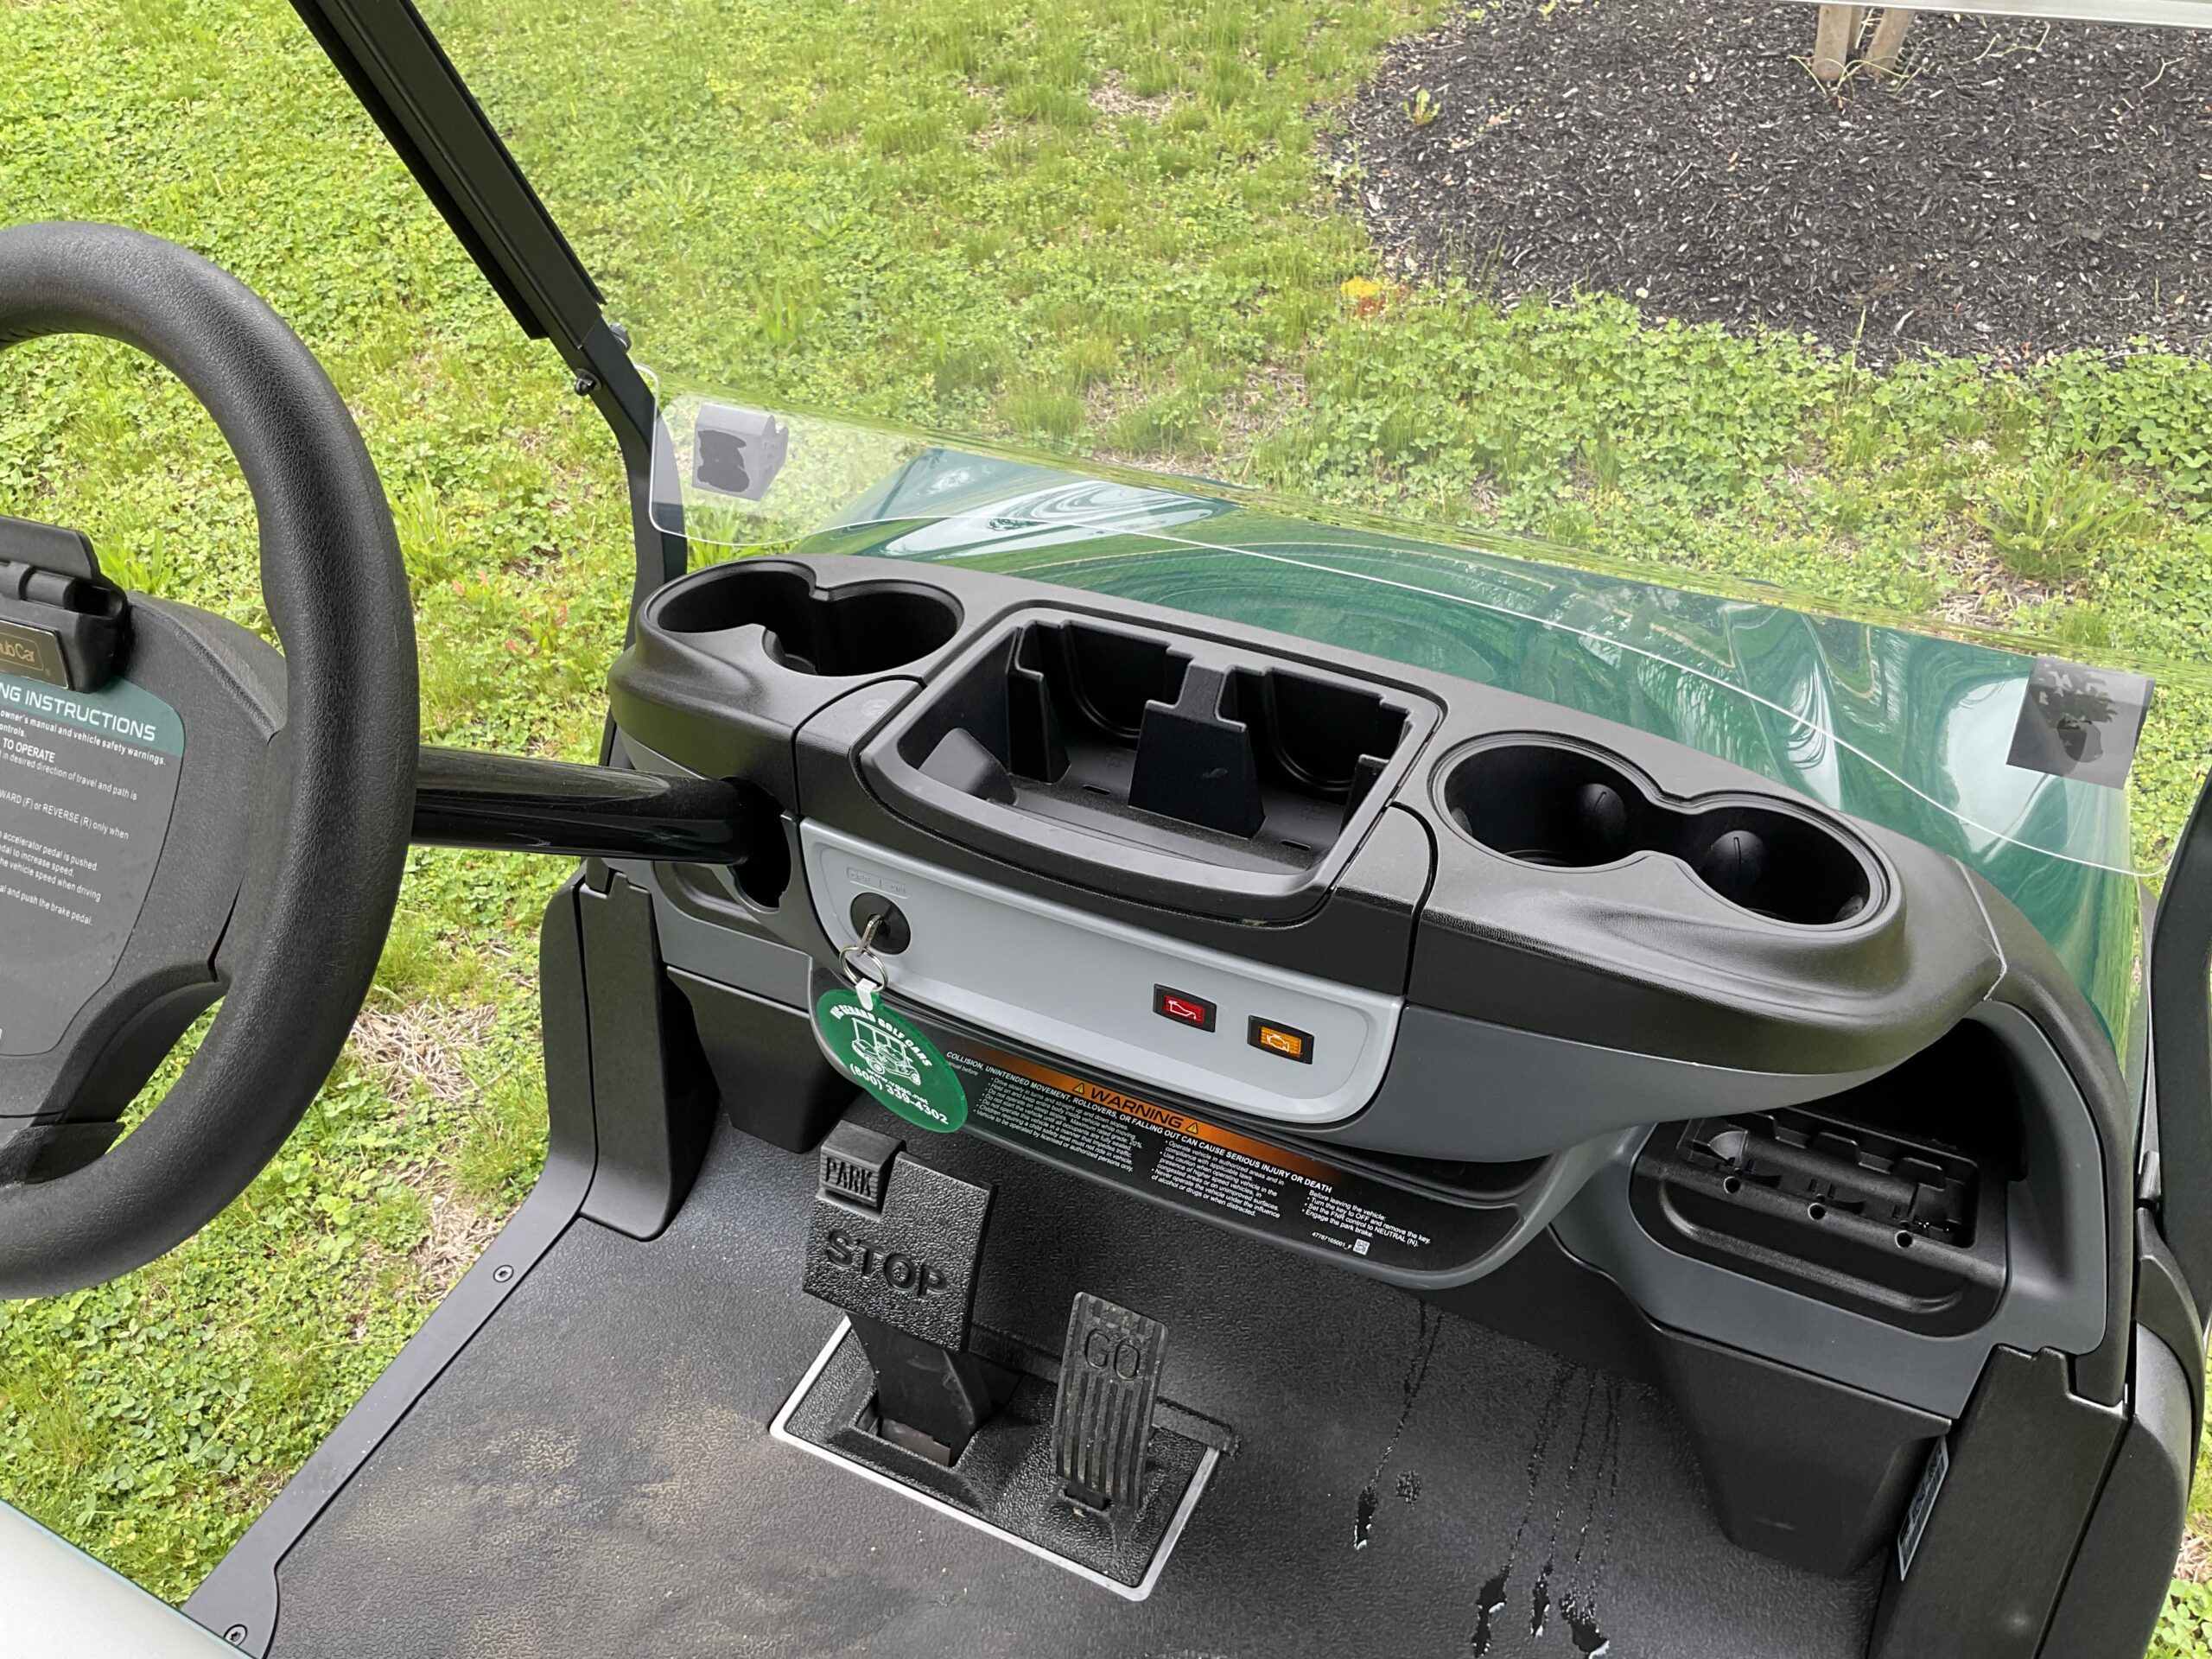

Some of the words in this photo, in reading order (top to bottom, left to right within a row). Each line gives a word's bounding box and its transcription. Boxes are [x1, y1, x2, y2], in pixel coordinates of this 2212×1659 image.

[25, 690, 156, 742] INSTRUCTIONS
[1, 710, 29, 724] owner's
[30, 719, 57, 733] manual
[58, 727, 72, 737] and
[73, 732, 100, 746] vehicle
[102, 740, 125, 755] safety
[127, 747, 166, 766] warnings.
[2, 737, 14, 750] TO
[16, 741, 55, 763] OPERATE
[10, 753, 35, 768] desired
[37, 761, 67, 778] direction
[68, 772, 75, 781] of
[76, 774, 97, 787] travel
[98, 782, 111, 792] and
[113, 787, 130, 798] path
[130, 791, 137, 800] is
[22, 797, 33, 810] (F)
[35, 802, 41, 810] or
[42, 803, 79, 823] REVERSE
[80, 816, 92, 830] (R)
[93, 822, 108, 835] only
[109, 827, 129, 839] when
[3, 833, 42, 852] accelerator
[43, 846, 62, 858] pedal
[64, 852, 69, 861] is
[71, 855, 99, 871] pushed.
[13, 849, 20, 857] to
[22, 851, 50, 868] increase
[52, 863, 75, 877] speed.
[10, 861, 34, 876] vehicle
[35, 871, 56, 884] speed
[58, 879, 75, 891] when
[77, 884, 101, 902] driving
[7, 887, 20, 899] and
[21, 893, 38, 905] push
[39, 899, 49, 909] the
[51, 902, 70, 917] brake
[72, 912, 92, 925] pedal.
[878, 1018, 905, 1039] GOLF
[905, 1039, 932, 1066] CARS
[850, 1064, 882, 1090] (800)
[886, 1084, 949, 1125] 339-4302
[1090, 1088, 1185, 1128] WARNING
[946, 1051, 983, 1071] COLLISION,
[985, 1065, 1031, 1085] UNINTENDED
[1030, 1081, 1071, 1102] MOVEMENT,
[1072, 1096, 1117, 1118] ROLLOVERS,
[1119, 1113, 1132, 1122] OR
[1132, 1117, 1164, 1134] FALLING
[1164, 1128, 1181, 1140] OUT
[1181, 1135, 1198, 1146] CAN
[1198, 1141, 1226, 1155] CAUSE
[1226, 1151, 1261, 1167] SERIOUS
[1261, 1163, 1291, 1178] INJURY
[1290, 1173, 1304, 1183] OR
[1304, 1179, 1332, 1193] DEATH
[976, 1109, 995, 1120] Vehicle
[1009, 1122, 1033, 1134] operated
[1040, 1134, 1064, 1145] licensed
[1070, 1145, 1098, 1158] authorized
[1097, 1155, 1121, 1166] persons
[825, 1157, 873, 1198] PARK
[1159, 1158, 1185, 1170] presence
[1192, 1169, 1211, 1179] higher
[1211, 1177, 1230, 1185] speed
[1230, 1183, 1254, 1196] vehicles,
[1166, 1147, 1197, 1160] compliance
[1210, 1162, 1238, 1175] applicable
[1239, 1172, 1253, 1181] laws.
[1168, 1141, 1192, 1152] Operate
[1192, 1149, 1212, 1160] vehicle
[1218, 1159, 1249, 1173] authorized
[1249, 1170, 1266, 1179] areas
[1175, 1157, 1196, 1166] caution
[1212, 1170, 1239, 1184] operating
[1240, 1179, 1261, 1190] vehicle
[1154, 1168, 1173, 1179] Never
[1172, 1176, 1194, 1186] operate
[1205, 1187, 1225, 1198] vehicle
[1225, 1195, 1243, 1204] under
[1254, 1205, 1281, 1217] influence
[1157, 1164, 1186, 1177] congested
[1186, 1174, 1203, 1183] areas
[1219, 1186, 1253, 1201] unimproved
[1253, 1198, 1279, 1211] surfaces.
[1158, 1178, 1179, 1188] alcohol
[1185, 1186, 1203, 1197] drugs
[1226, 1202, 1255, 1216] distracted.
[1309, 1190, 1329, 1201] Before
[1330, 1197, 1351, 1210] leaving
[1363, 1210, 1386, 1221] vehicle:
[1306, 1209, 1329, 1222] Engage
[1355, 1227, 1373, 1237] brake.
[1311, 1197, 1325, 1206] Turn
[1336, 1206, 1347, 1215] key
[1355, 1213, 1370, 1222] OFF
[1383, 1224, 1407, 1235] remove
[1418, 1235, 1430, 1244] key.
[1330, 1211, 1345, 1220] FNR
[1345, 1217, 1367, 1228] control
[1374, 1227, 1407, 1242] NEUTRAL
[1406, 1238, 1418, 1247] (N).
[827, 1230, 948, 1297] STOP
[1084, 1329, 1140, 1380] GO
